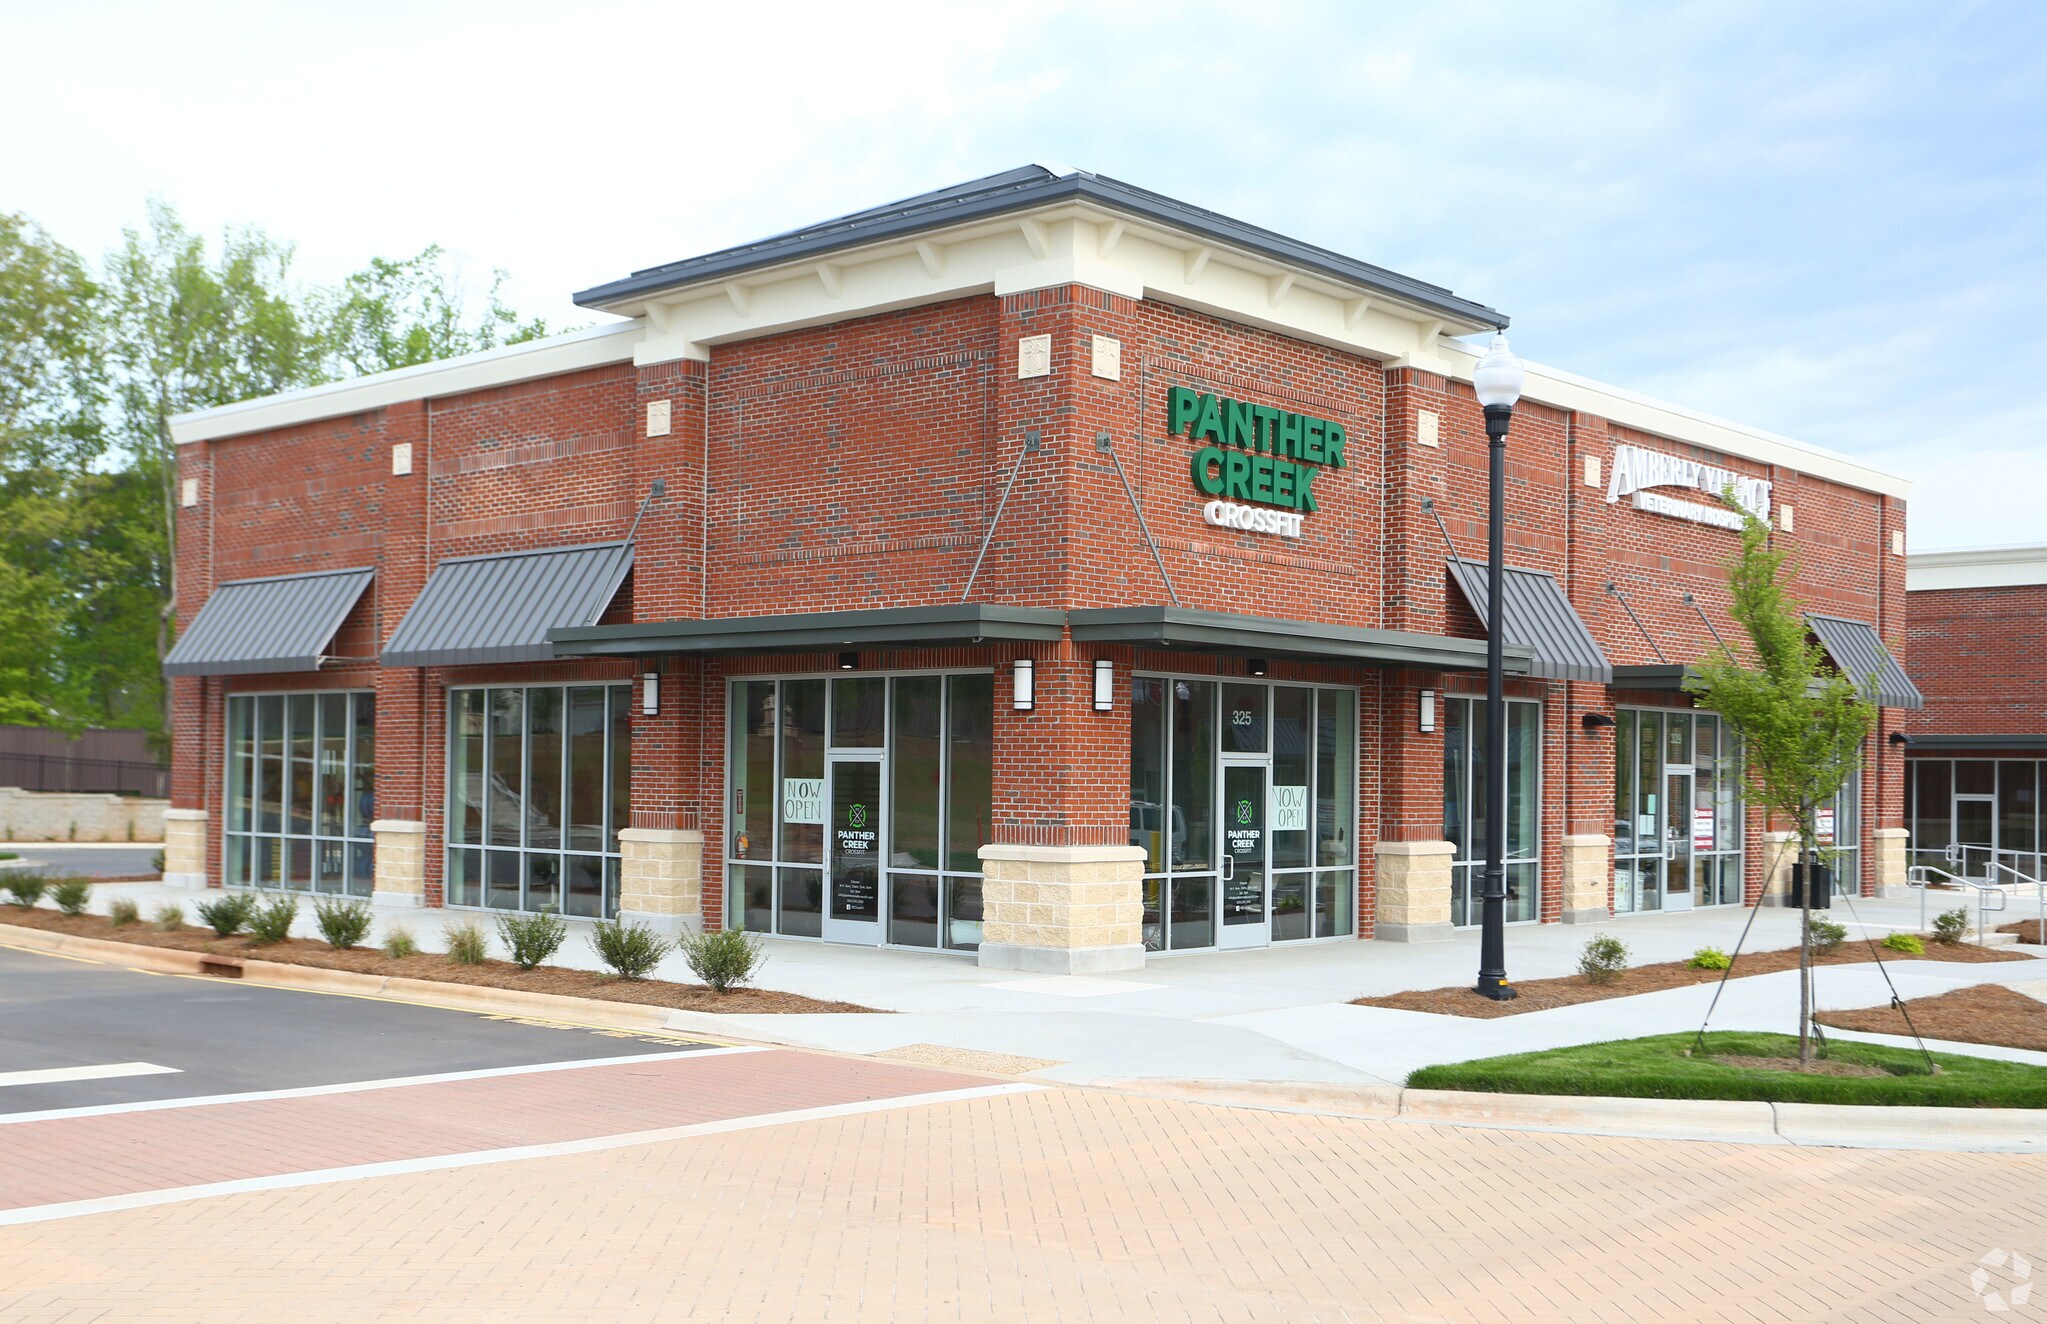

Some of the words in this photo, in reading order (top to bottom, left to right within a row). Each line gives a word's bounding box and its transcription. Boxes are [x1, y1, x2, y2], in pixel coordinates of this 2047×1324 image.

[1168, 386, 1347, 467] PANTHER
[1191, 447, 1319, 511] CREEK
[1607, 445, 1702, 503] AMBERLY
[1633, 491, 1704, 522] VETERINARY
[1204, 500, 1304, 538] CROSSFIT
[1232, 710, 1252, 725] 325
[787, 781, 822, 799] NOW
[1272, 787, 1305, 808] NOW
[785, 799, 822, 820] OPEN
[1278, 808, 1304, 827] OPEN
[837, 830, 875, 840] PANTHER
[842, 840, 869, 849] CREEK
[1227, 830, 1261, 839] PANTHER
[1232, 839, 1255, 848] CREEK
